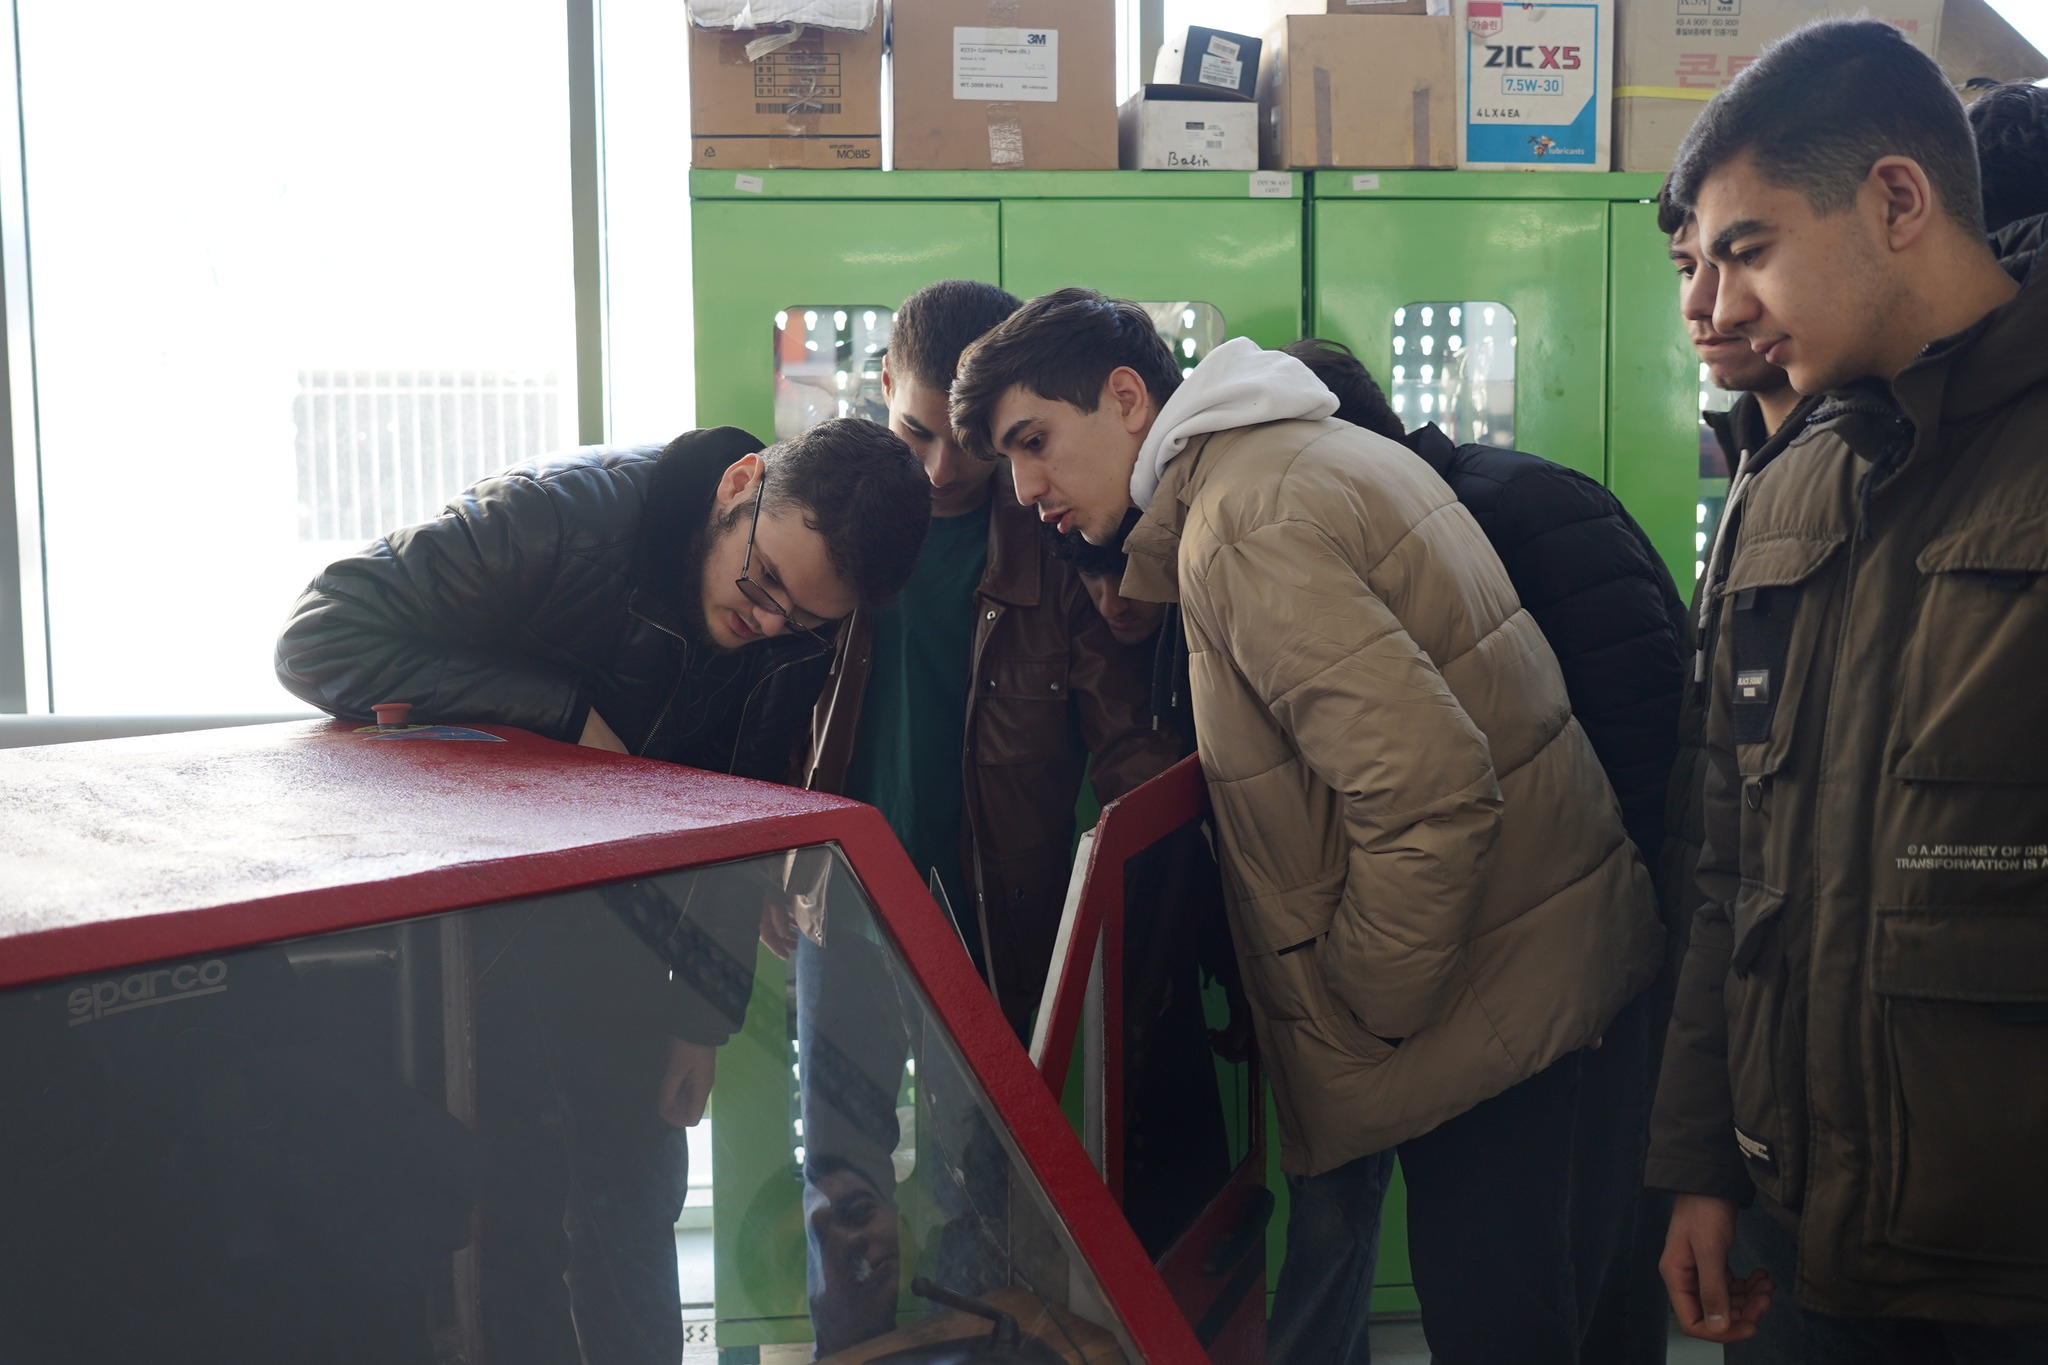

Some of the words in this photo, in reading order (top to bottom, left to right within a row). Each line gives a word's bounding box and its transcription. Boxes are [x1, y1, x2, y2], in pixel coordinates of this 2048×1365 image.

[1472, 21, 1497, 30] 가솔린
[1027, 34, 1046, 45] 3M
[1483, 45, 1535, 68] ZIC
[1538, 46, 1581, 70] X5
[1505, 79, 1559, 92] 7.5W-30
[837, 150, 870, 159] MOBIS
[1549, 146, 1585, 155] lubricants
[1919, 845, 1928, 856] A
[1931, 845, 1997, 857] JOURNEY
[2001, 845, 2022, 857] OF
[1895, 857, 2020, 870] TRANSFORMATION
[2023, 858, 2037, 870] IS
[67, 959, 228, 1019] sparco
